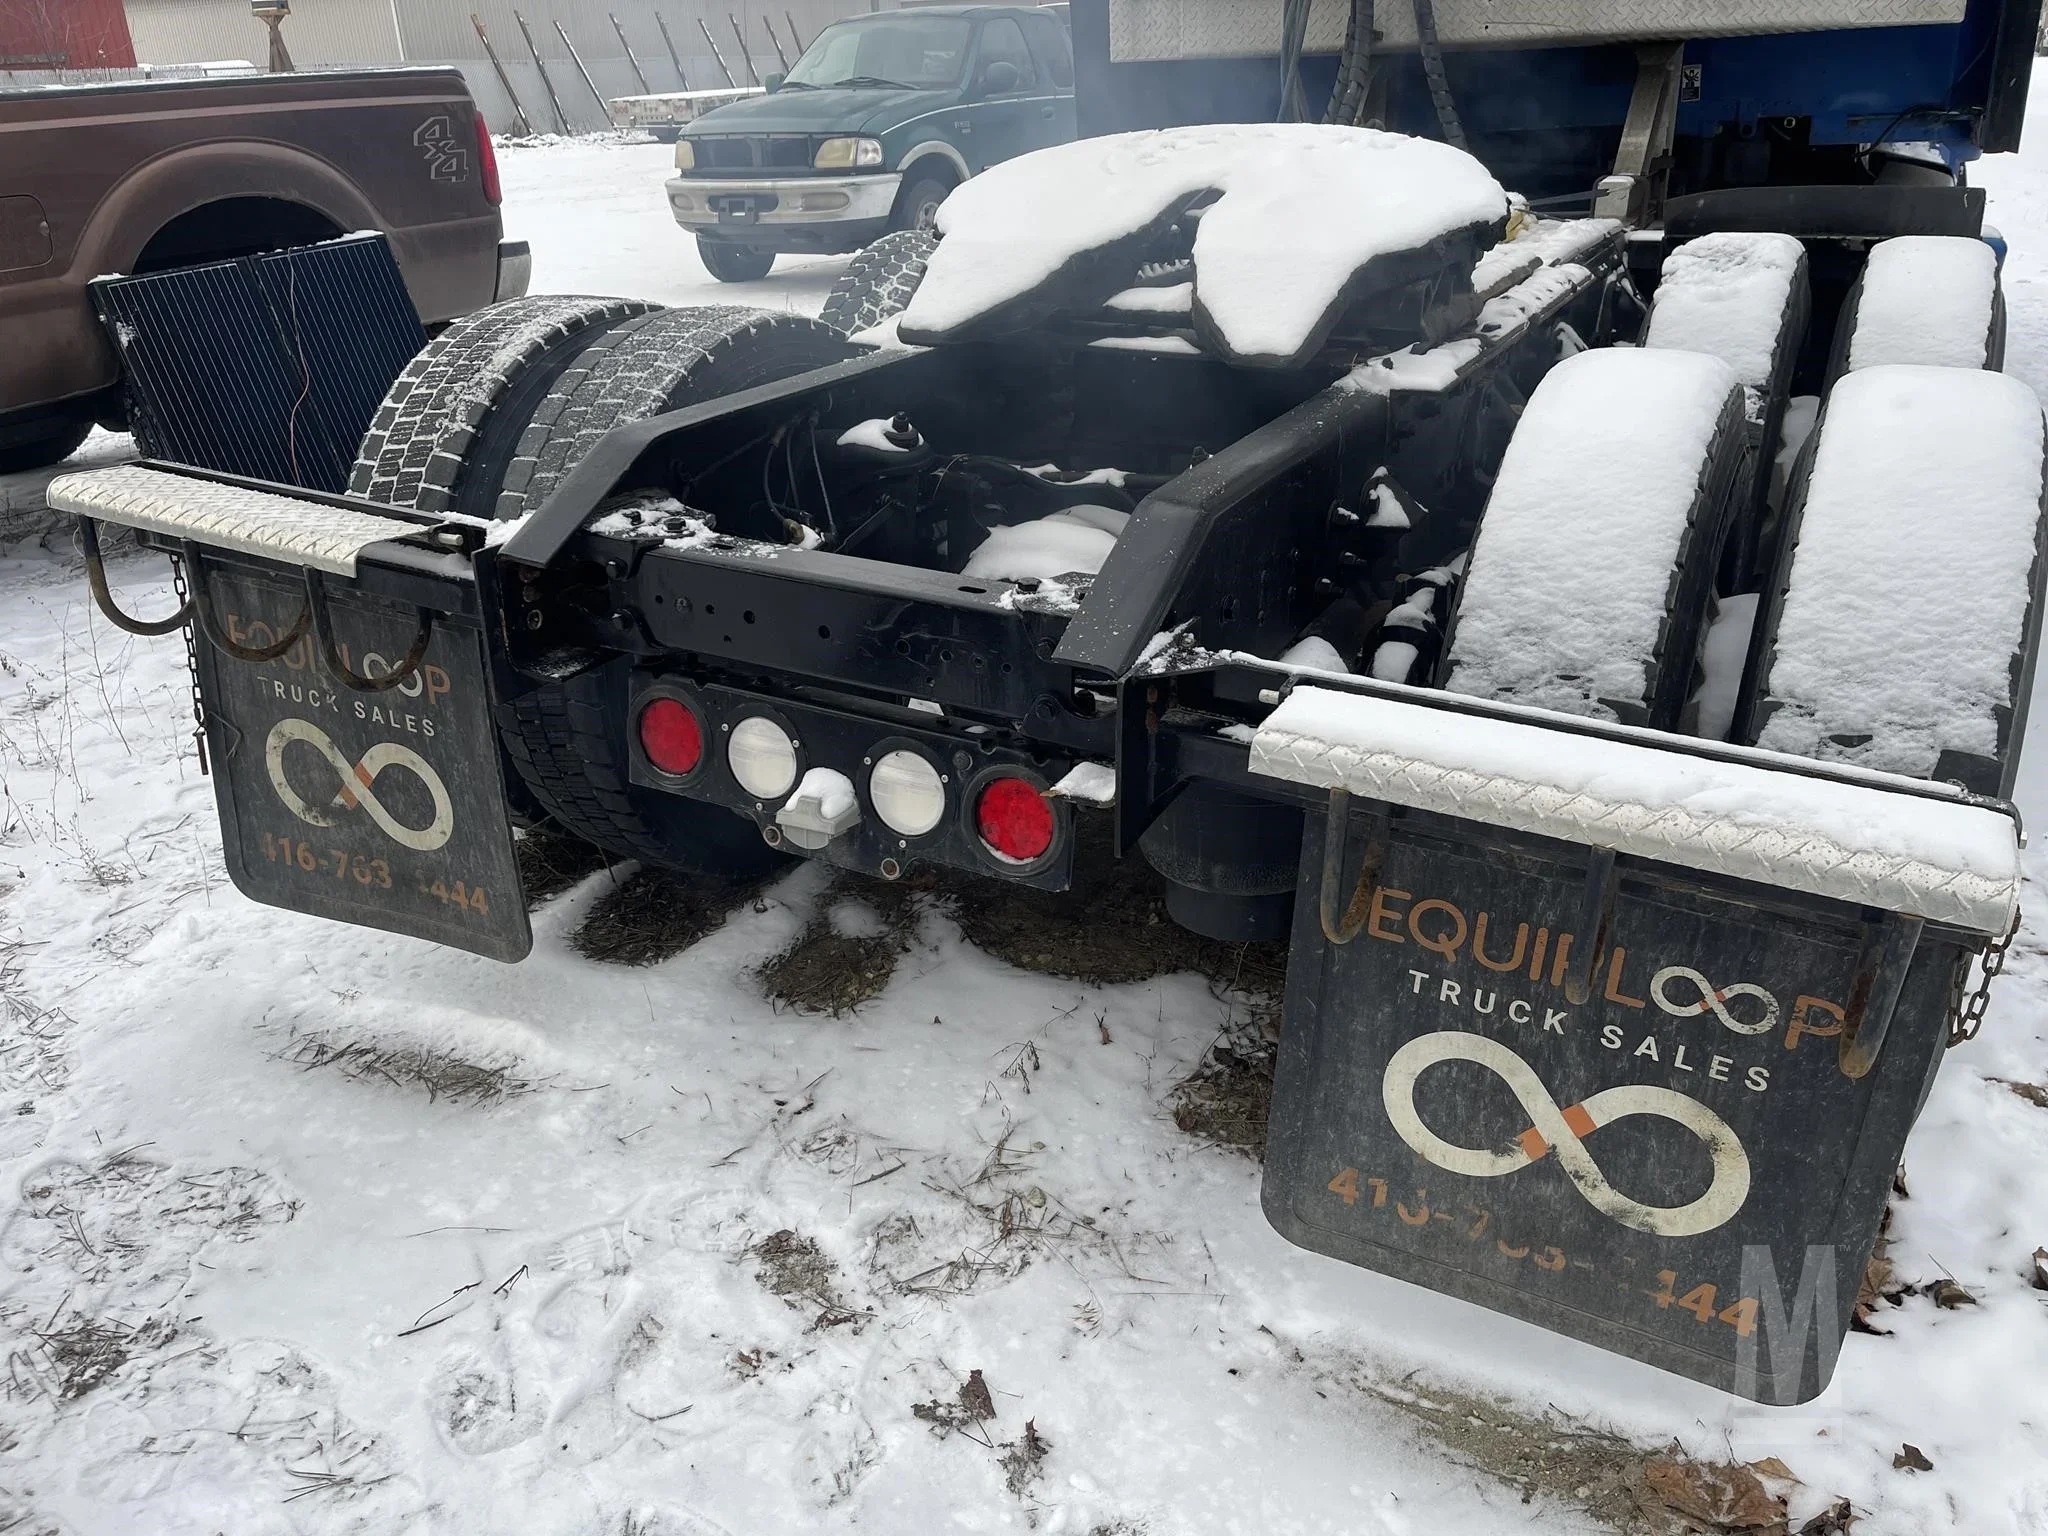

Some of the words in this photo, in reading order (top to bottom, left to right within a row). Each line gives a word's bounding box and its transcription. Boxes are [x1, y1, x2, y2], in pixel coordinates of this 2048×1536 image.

[354, 700, 435, 737] SALES
[1408, 968, 1569, 1036] TRUCK
[1599, 1024, 1771, 1093] SALES
